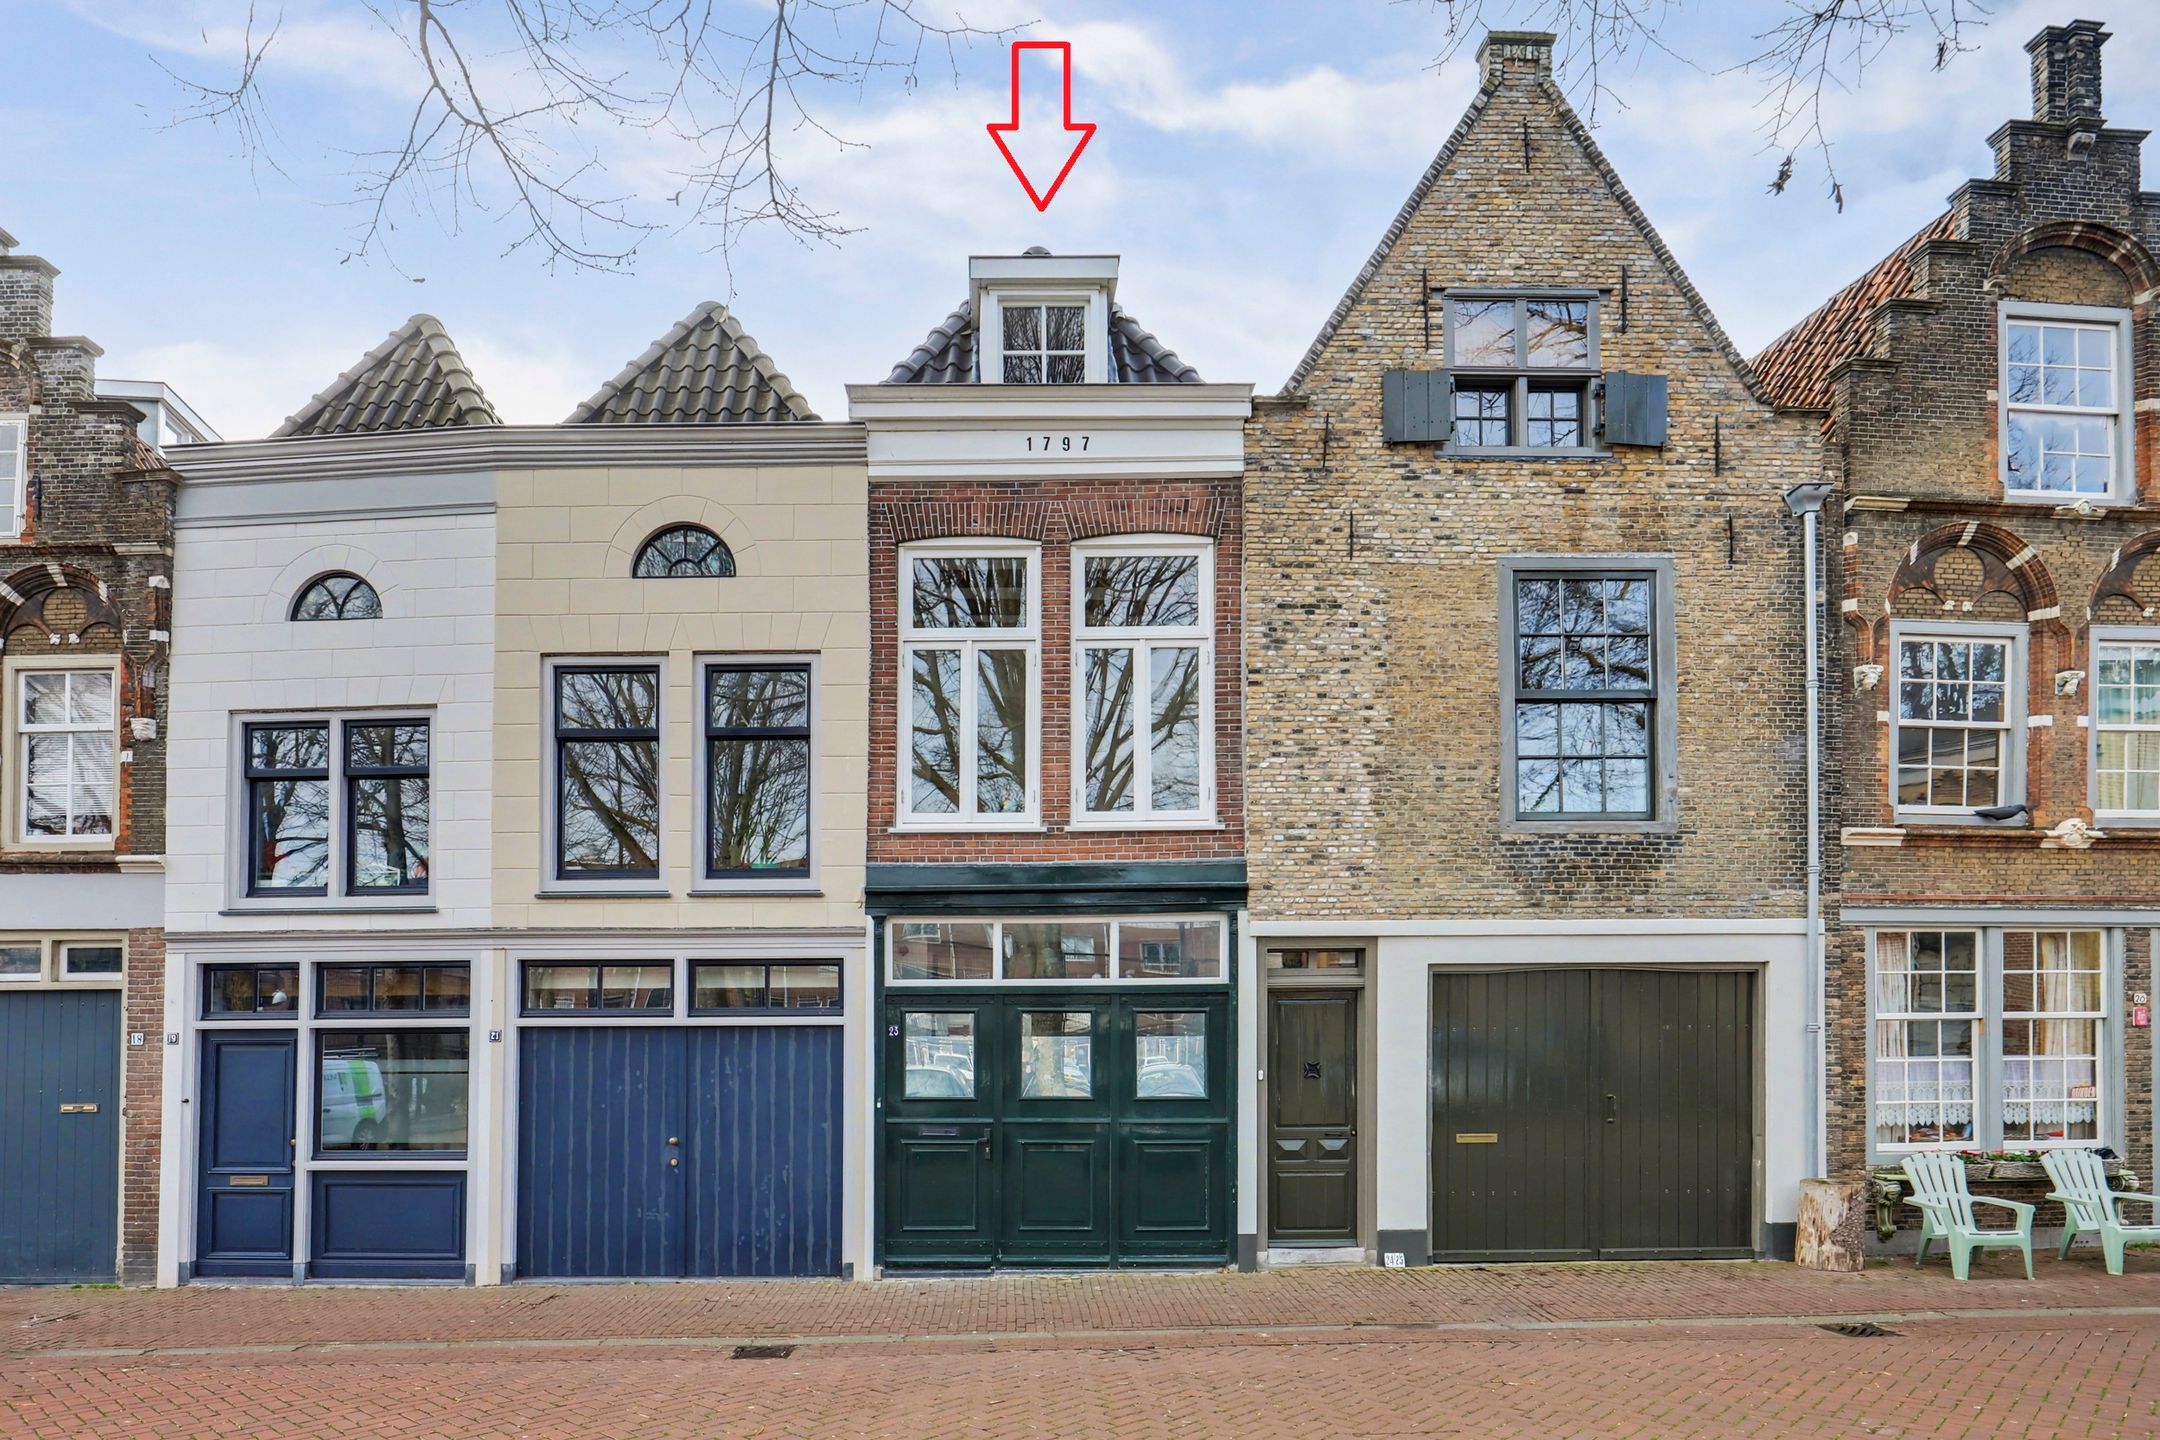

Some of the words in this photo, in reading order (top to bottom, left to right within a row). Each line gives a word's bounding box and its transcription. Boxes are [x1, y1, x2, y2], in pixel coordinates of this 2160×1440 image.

[1026, 436, 1090, 451] 1797
[888, 1026, 899, 1036] 23
[132, 1034, 143, 1044] 18
